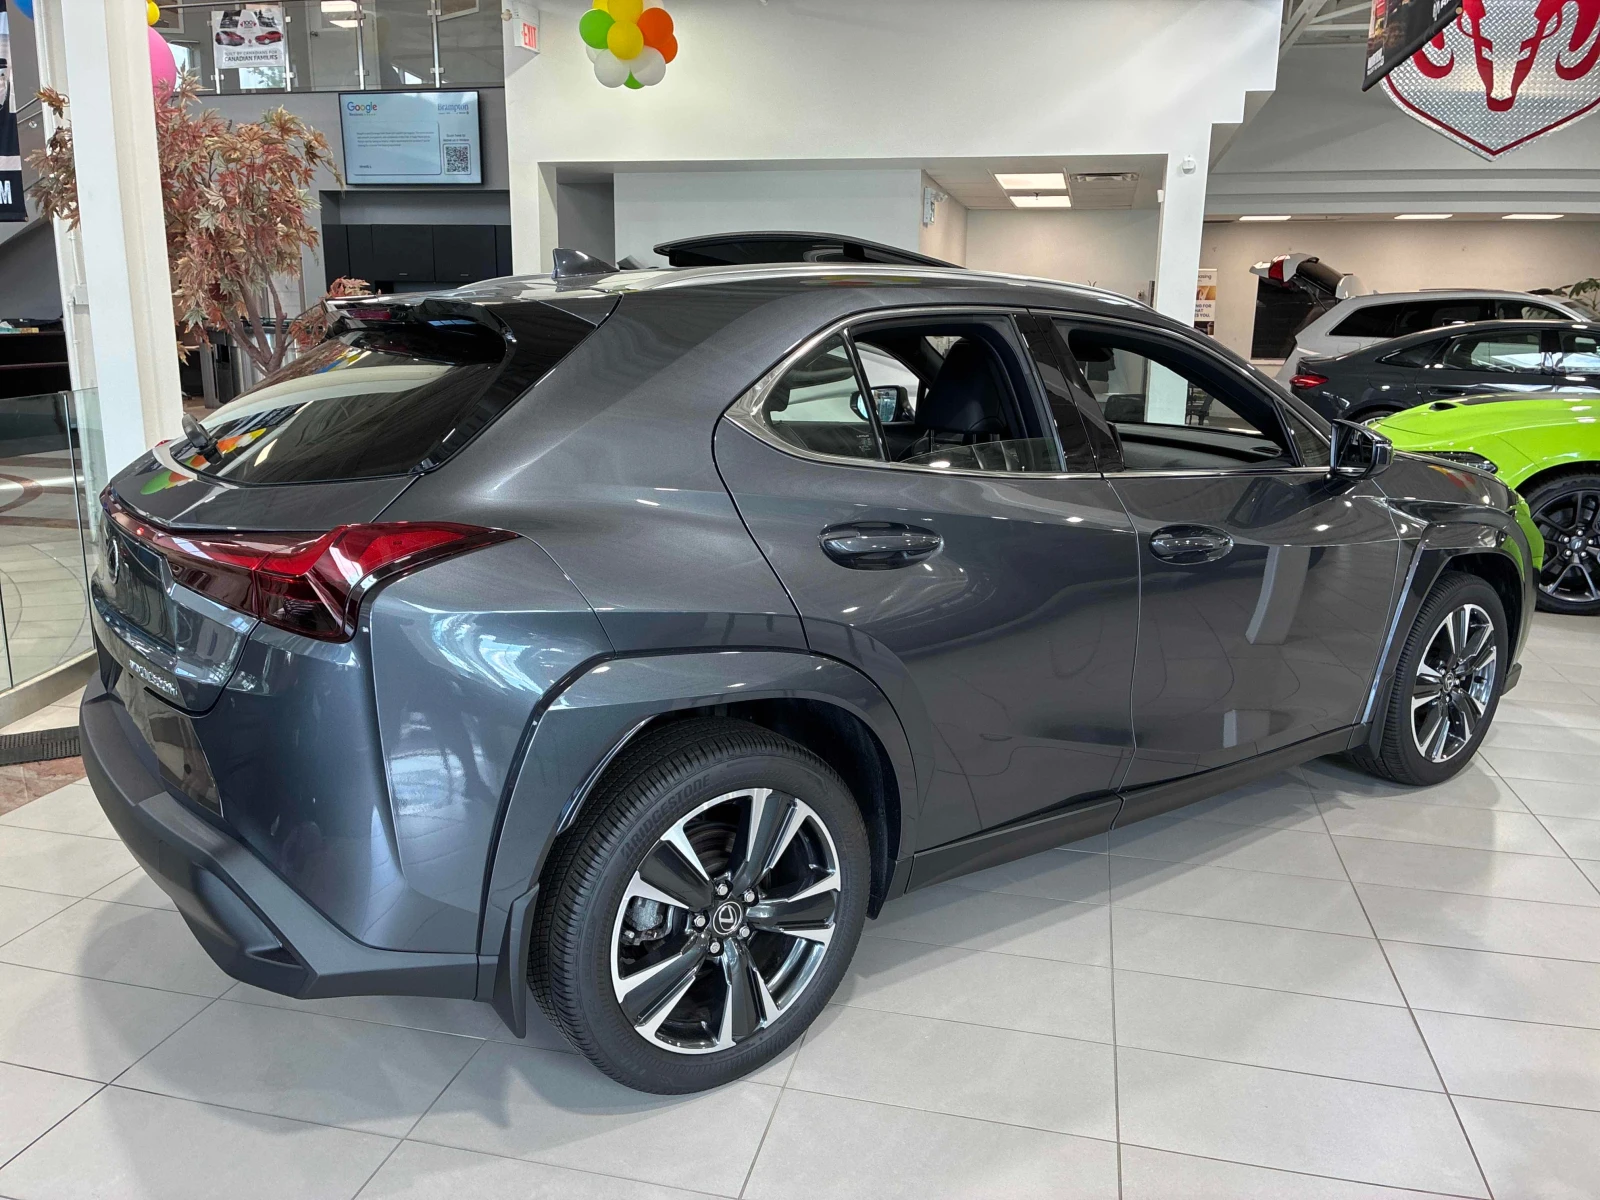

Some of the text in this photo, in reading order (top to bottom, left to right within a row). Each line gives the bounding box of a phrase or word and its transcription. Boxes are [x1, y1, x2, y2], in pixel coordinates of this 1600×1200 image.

[522, 22, 537, 49] EXIT
[347, 101, 378, 113] Google
[621, 774, 710, 859] BRIDGESTONE
